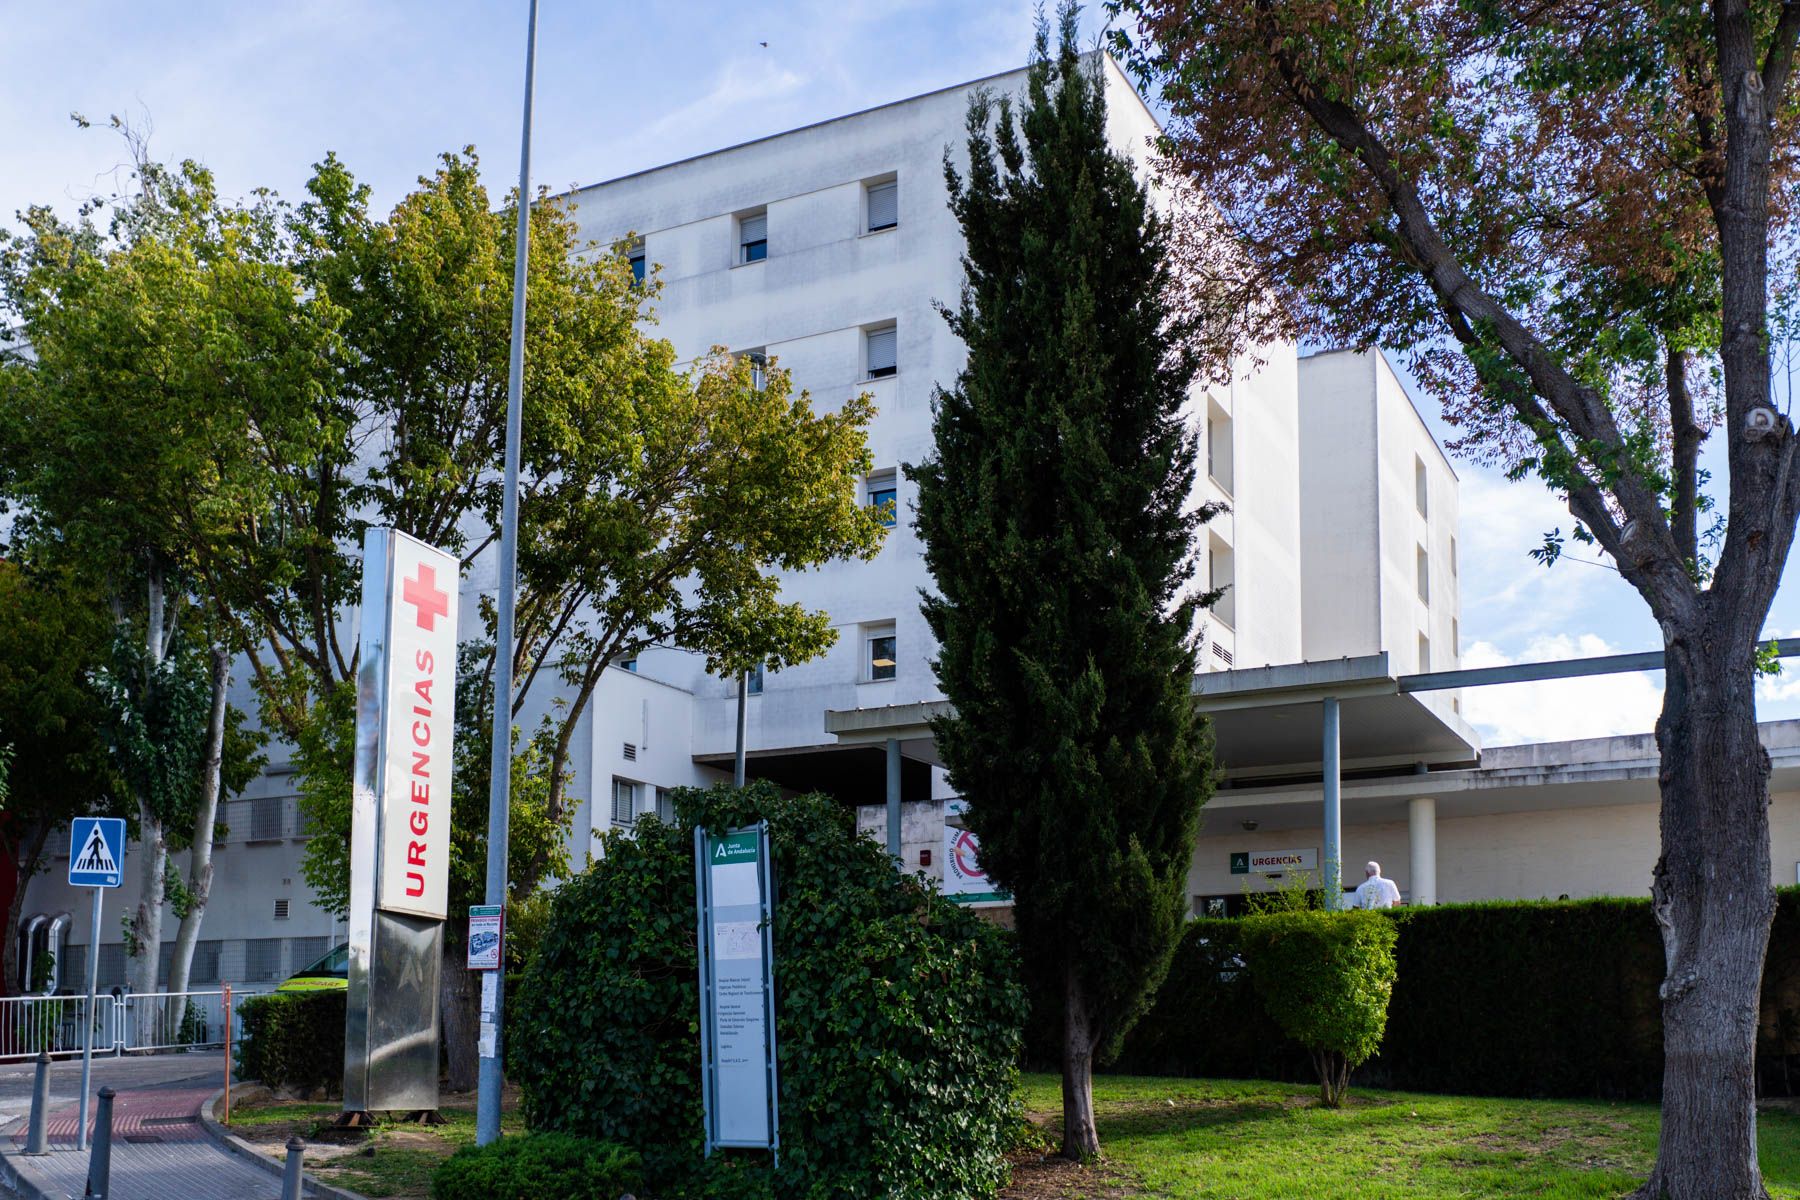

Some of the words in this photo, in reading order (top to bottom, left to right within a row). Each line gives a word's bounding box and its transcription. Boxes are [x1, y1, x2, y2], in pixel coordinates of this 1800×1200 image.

[406, 648, 434, 898] URGENCIAS
[951, 830, 961, 844] FUM
[733, 846, 756, 854] Andalucía
[948, 848, 963, 880] PROHIBIDO
[1252, 855, 1302, 866] URGENCIAS
